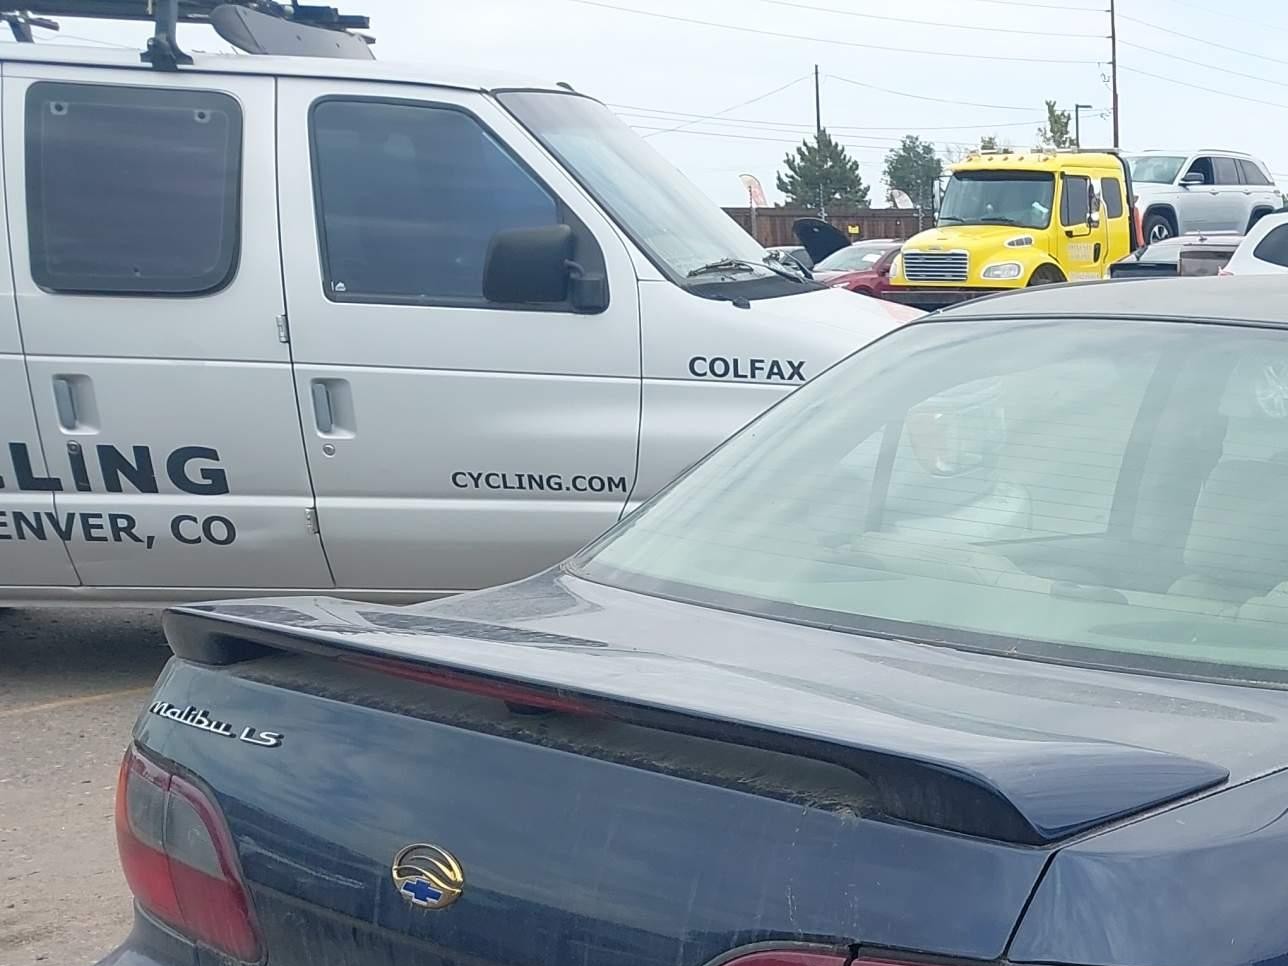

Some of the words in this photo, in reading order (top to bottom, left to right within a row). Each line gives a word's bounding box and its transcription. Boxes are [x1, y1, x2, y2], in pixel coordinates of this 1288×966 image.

[688, 356, 806, 382] COLFAX
[0, 441, 230, 495] LING
[450, 471, 628, 493] CYCLING.COM
[170, 514, 237, 546] CO
[150, 701, 232, 736] Malibu
[239, 726, 283, 747] LS
